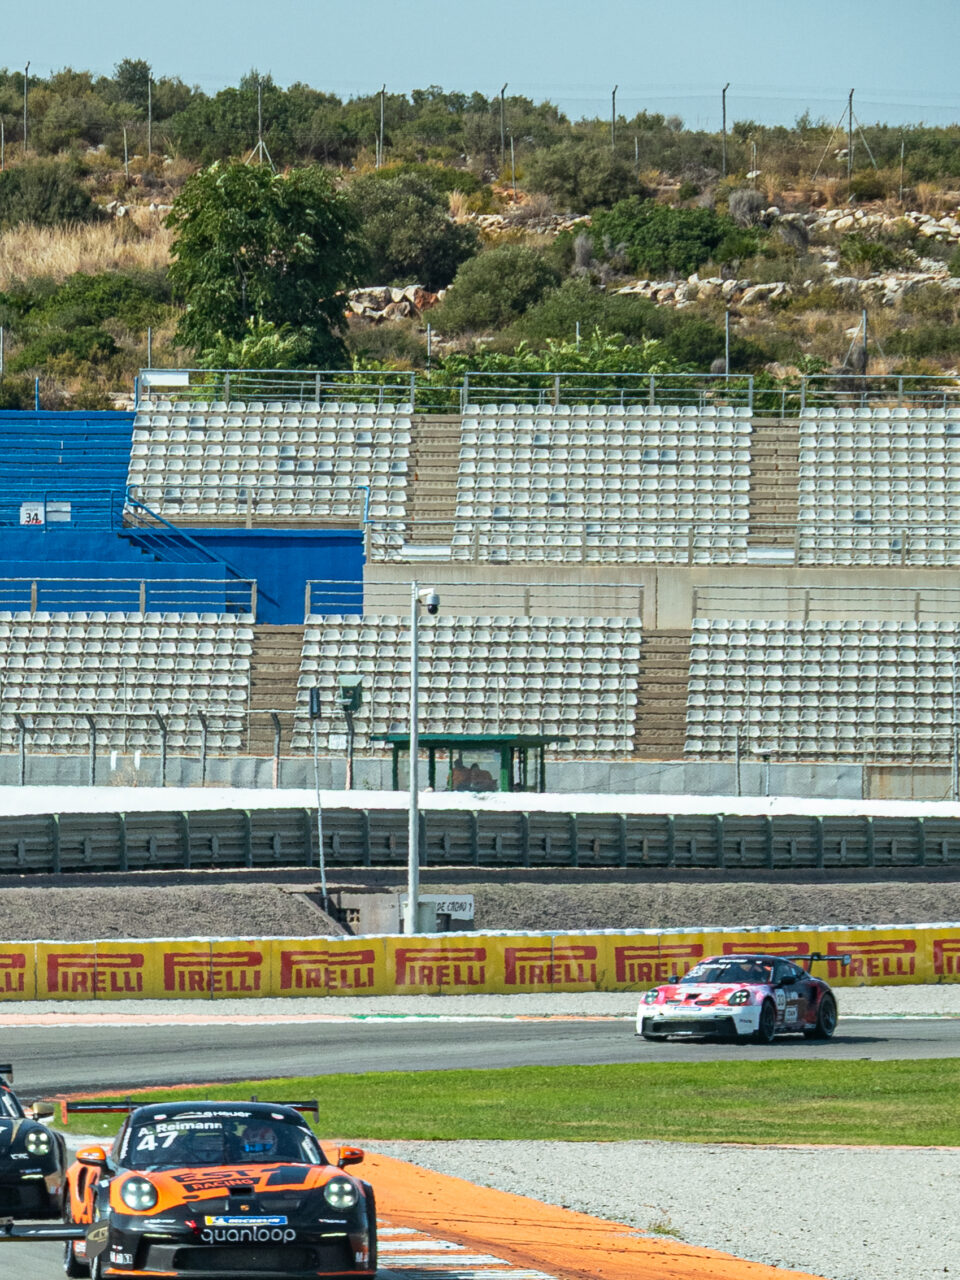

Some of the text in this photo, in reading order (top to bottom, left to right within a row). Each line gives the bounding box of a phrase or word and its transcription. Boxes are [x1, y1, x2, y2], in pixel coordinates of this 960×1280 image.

[25, 512, 39, 523] 34
[47, 953, 144, 991] PIRELLI
[164, 952, 263, 990] PIRELLI
[281, 950, 375, 988] PIRELLI
[395, 948, 486, 985] PIRELLI
[504, 946, 597, 984] PIRELLI
[615, 944, 703, 982] PIREL
[136, 1130, 179, 1151] 47
[138, 1121, 223, 1138] A. Reimann
[191, 1178, 255, 1191] RACING
[200, 1226, 297, 1245] quanloop
